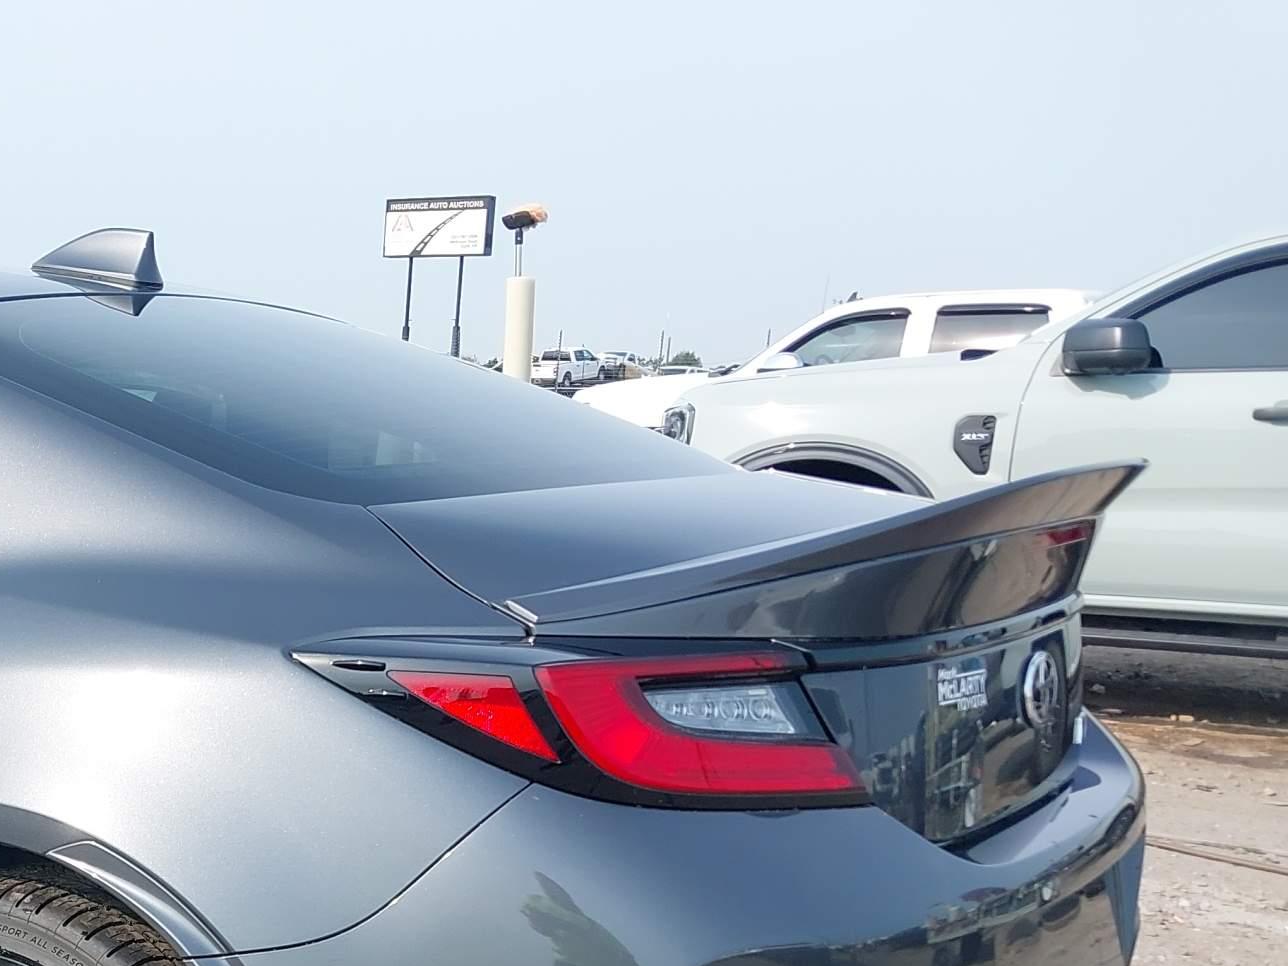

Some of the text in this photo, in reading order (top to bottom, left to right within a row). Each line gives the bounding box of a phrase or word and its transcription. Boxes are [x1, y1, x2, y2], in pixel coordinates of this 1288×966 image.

[390, 202, 429, 210] INSURANCE
[449, 200, 484, 208] AUCTIONS
[30, 936, 48, 950] ALL
